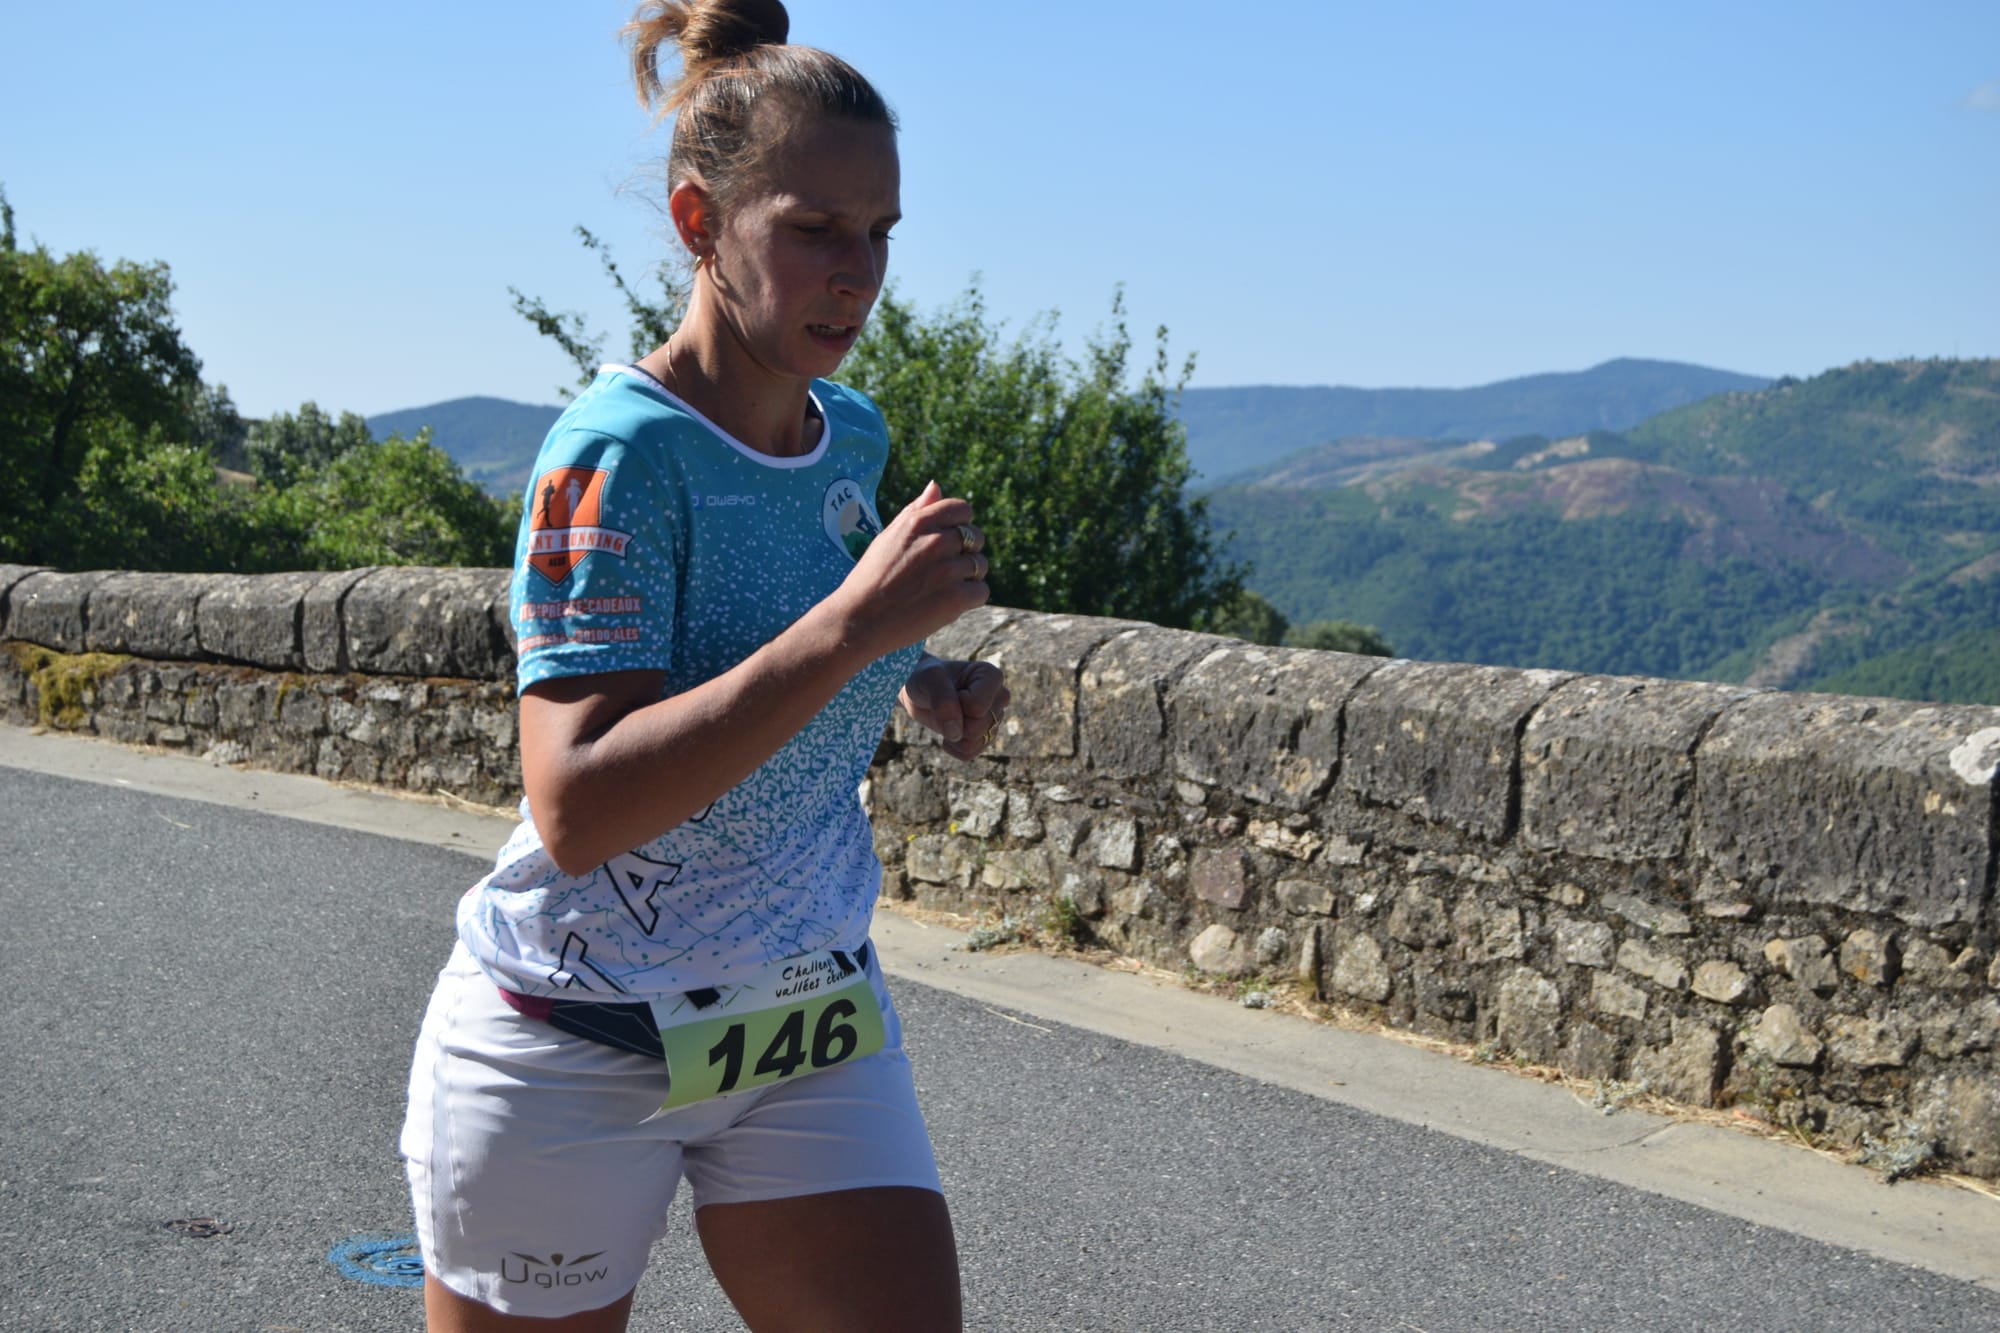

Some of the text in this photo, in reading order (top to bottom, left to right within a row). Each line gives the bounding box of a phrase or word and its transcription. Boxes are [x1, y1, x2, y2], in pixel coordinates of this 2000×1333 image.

[831, 487, 852, 511] TAC
[561, 531, 624, 552] RUNNING
[775, 977, 820, 997] vallées
[708, 998, 858, 1094] 146
[502, 1257, 608, 1288] Uglow
